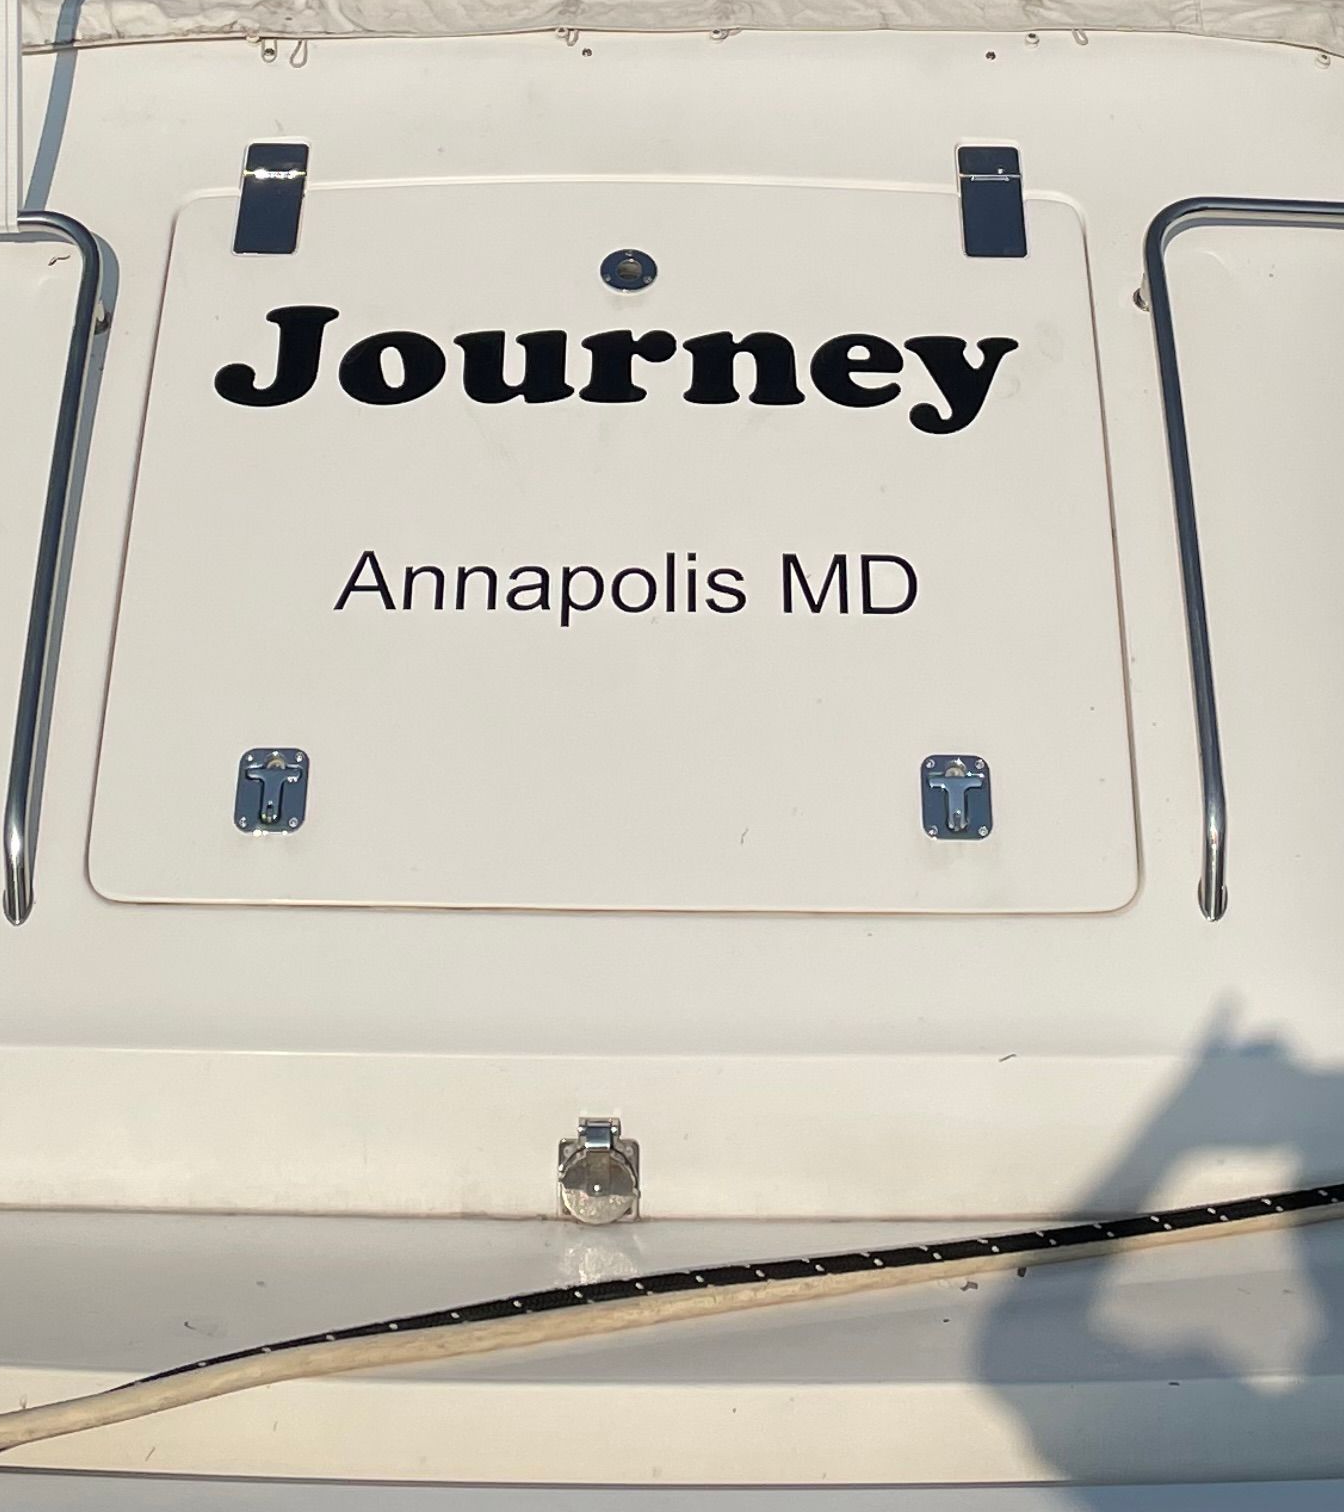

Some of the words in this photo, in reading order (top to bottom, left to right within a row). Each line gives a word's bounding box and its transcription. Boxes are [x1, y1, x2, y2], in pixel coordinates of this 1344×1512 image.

[214, 305, 1019, 435] Journey
[333, 550, 747, 628] Annapolis
[782, 553, 918, 615] MD
